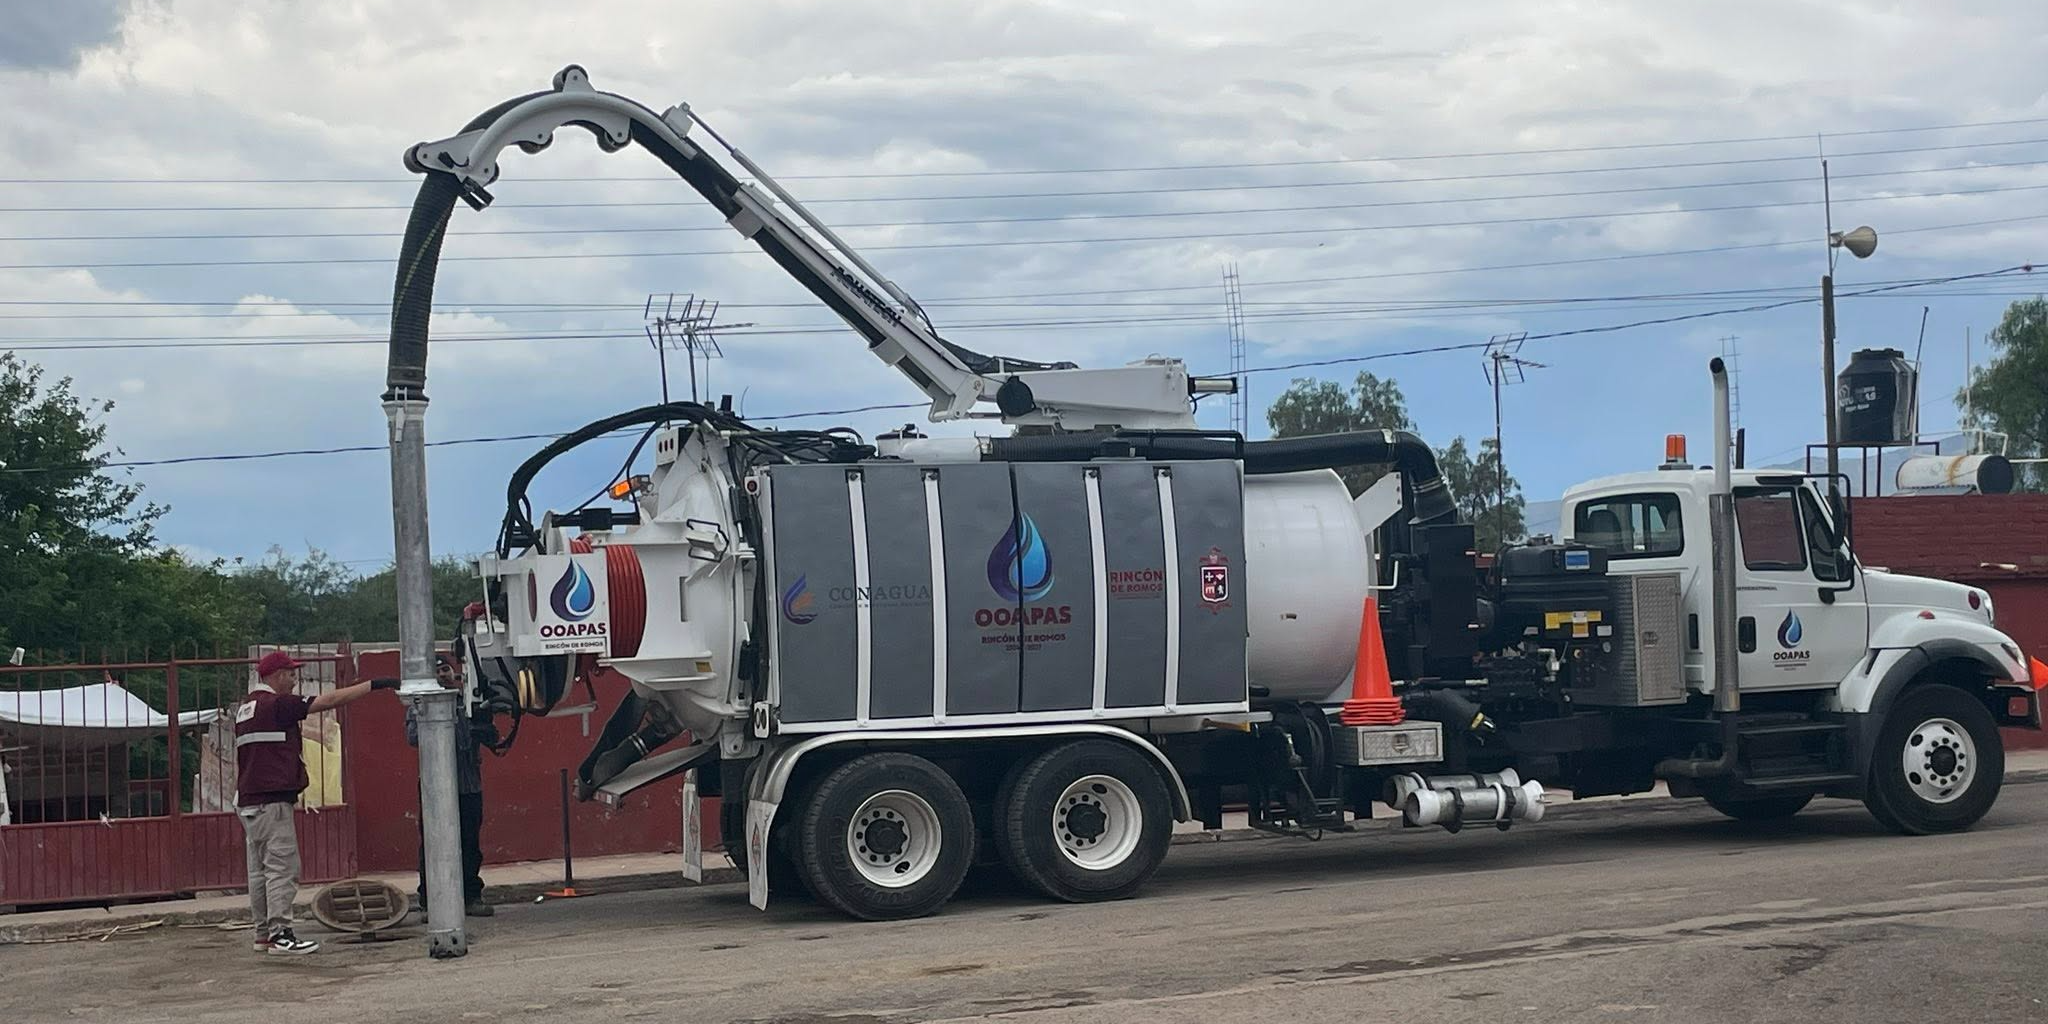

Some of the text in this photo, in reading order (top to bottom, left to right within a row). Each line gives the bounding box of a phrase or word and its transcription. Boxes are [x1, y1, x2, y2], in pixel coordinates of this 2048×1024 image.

[1110, 568, 1163, 583] RINCÓN
[829, 585, 932, 601] CONAGUA
[1110, 583, 1163, 593] DE ROMOS
[975, 606, 1072, 627] OOAPAS
[540, 622, 607, 638] OOAPAS
[982, 633, 1016, 644] RINCÓN
[1034, 633, 1066, 642] ROMOS
[1773, 650, 1810, 660] OOAPAS
